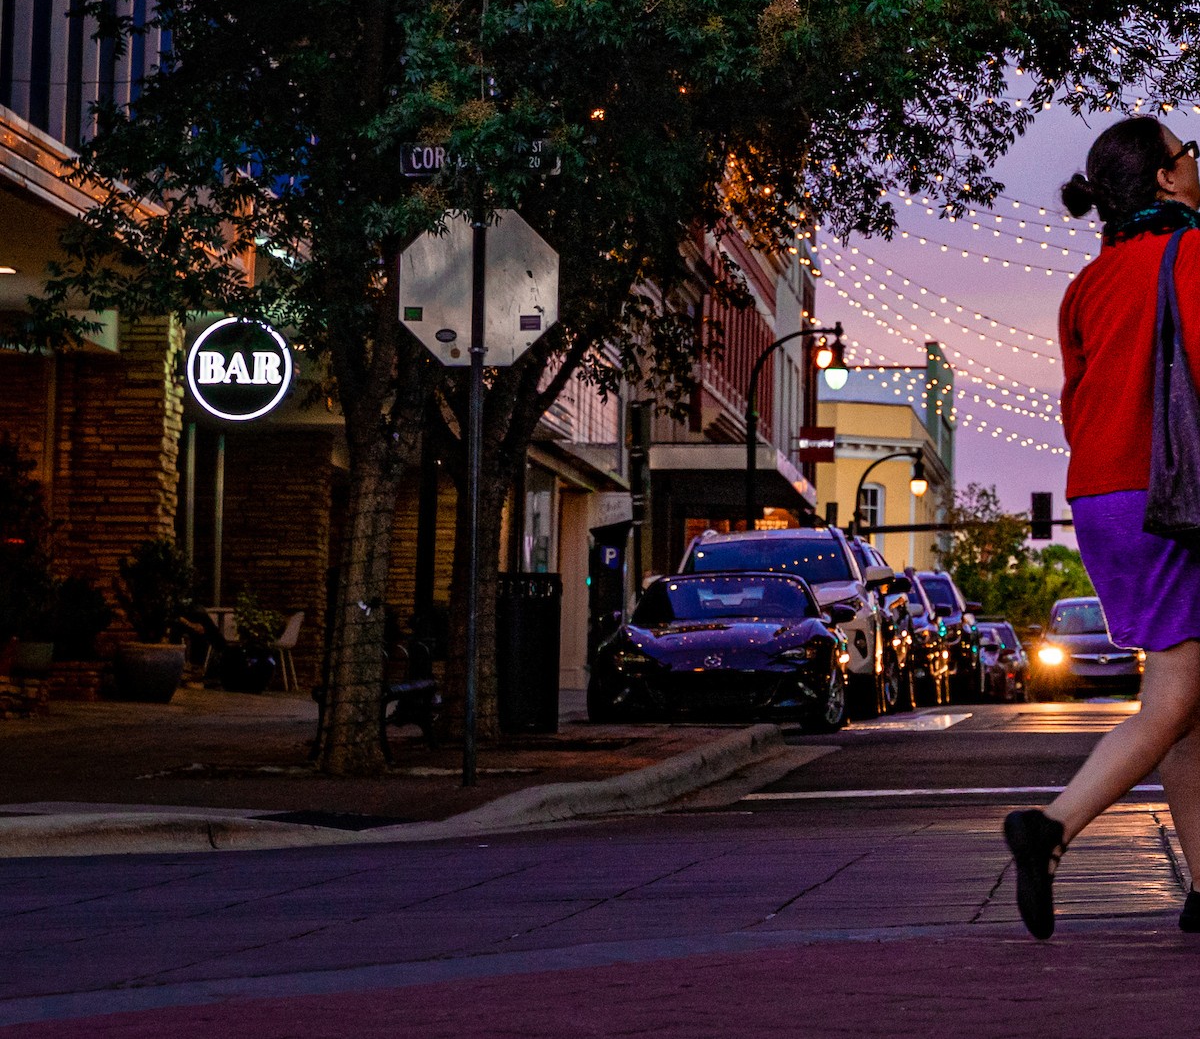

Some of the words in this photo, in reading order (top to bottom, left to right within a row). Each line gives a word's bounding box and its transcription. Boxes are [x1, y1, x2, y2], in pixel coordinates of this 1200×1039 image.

[532, 140, 543, 152] ST
[198, 351, 282, 384] BAR
[605, 547, 617, 565] P
